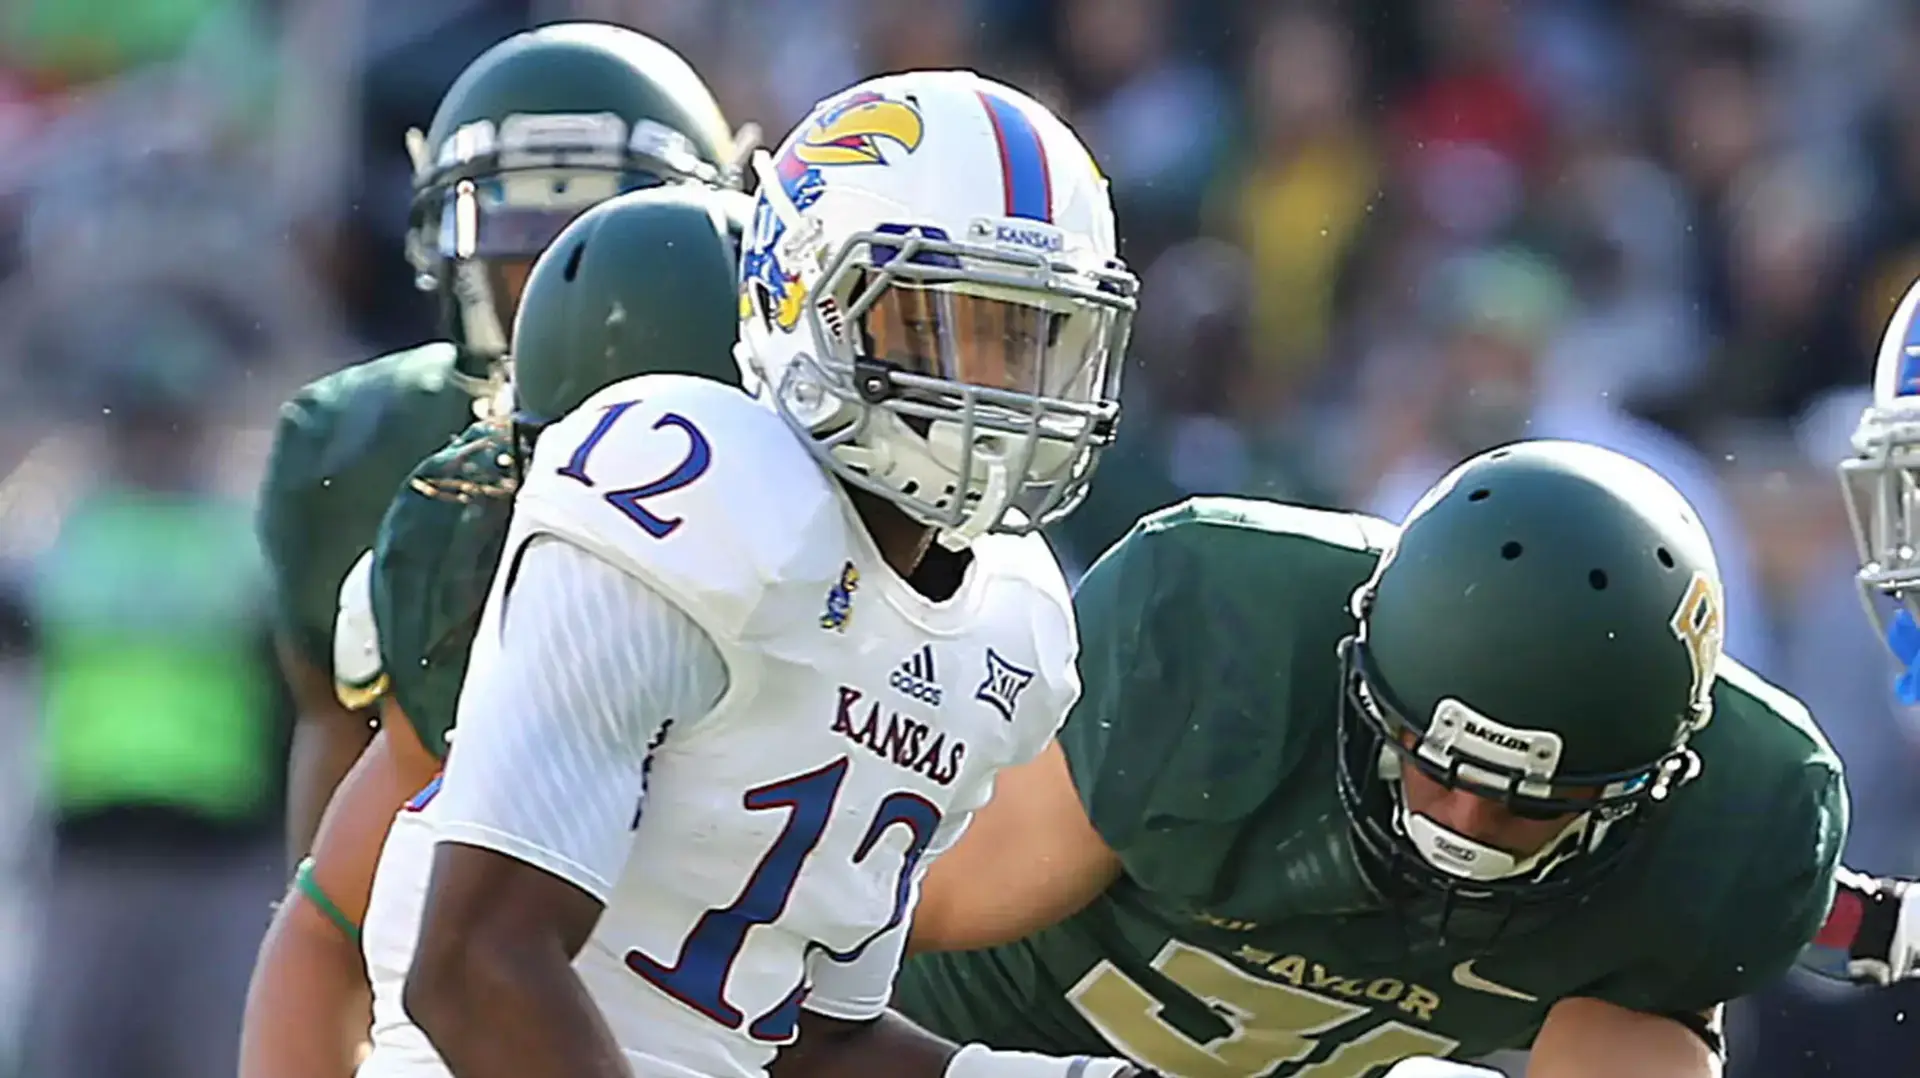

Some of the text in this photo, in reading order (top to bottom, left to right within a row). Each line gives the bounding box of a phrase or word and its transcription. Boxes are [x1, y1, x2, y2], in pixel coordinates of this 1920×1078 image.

[556, 400, 712, 539] 12
[831, 686, 965, 785] KANSAS
[1464, 721, 1531, 752] BAYLOR
[625, 755, 942, 1041] 12
